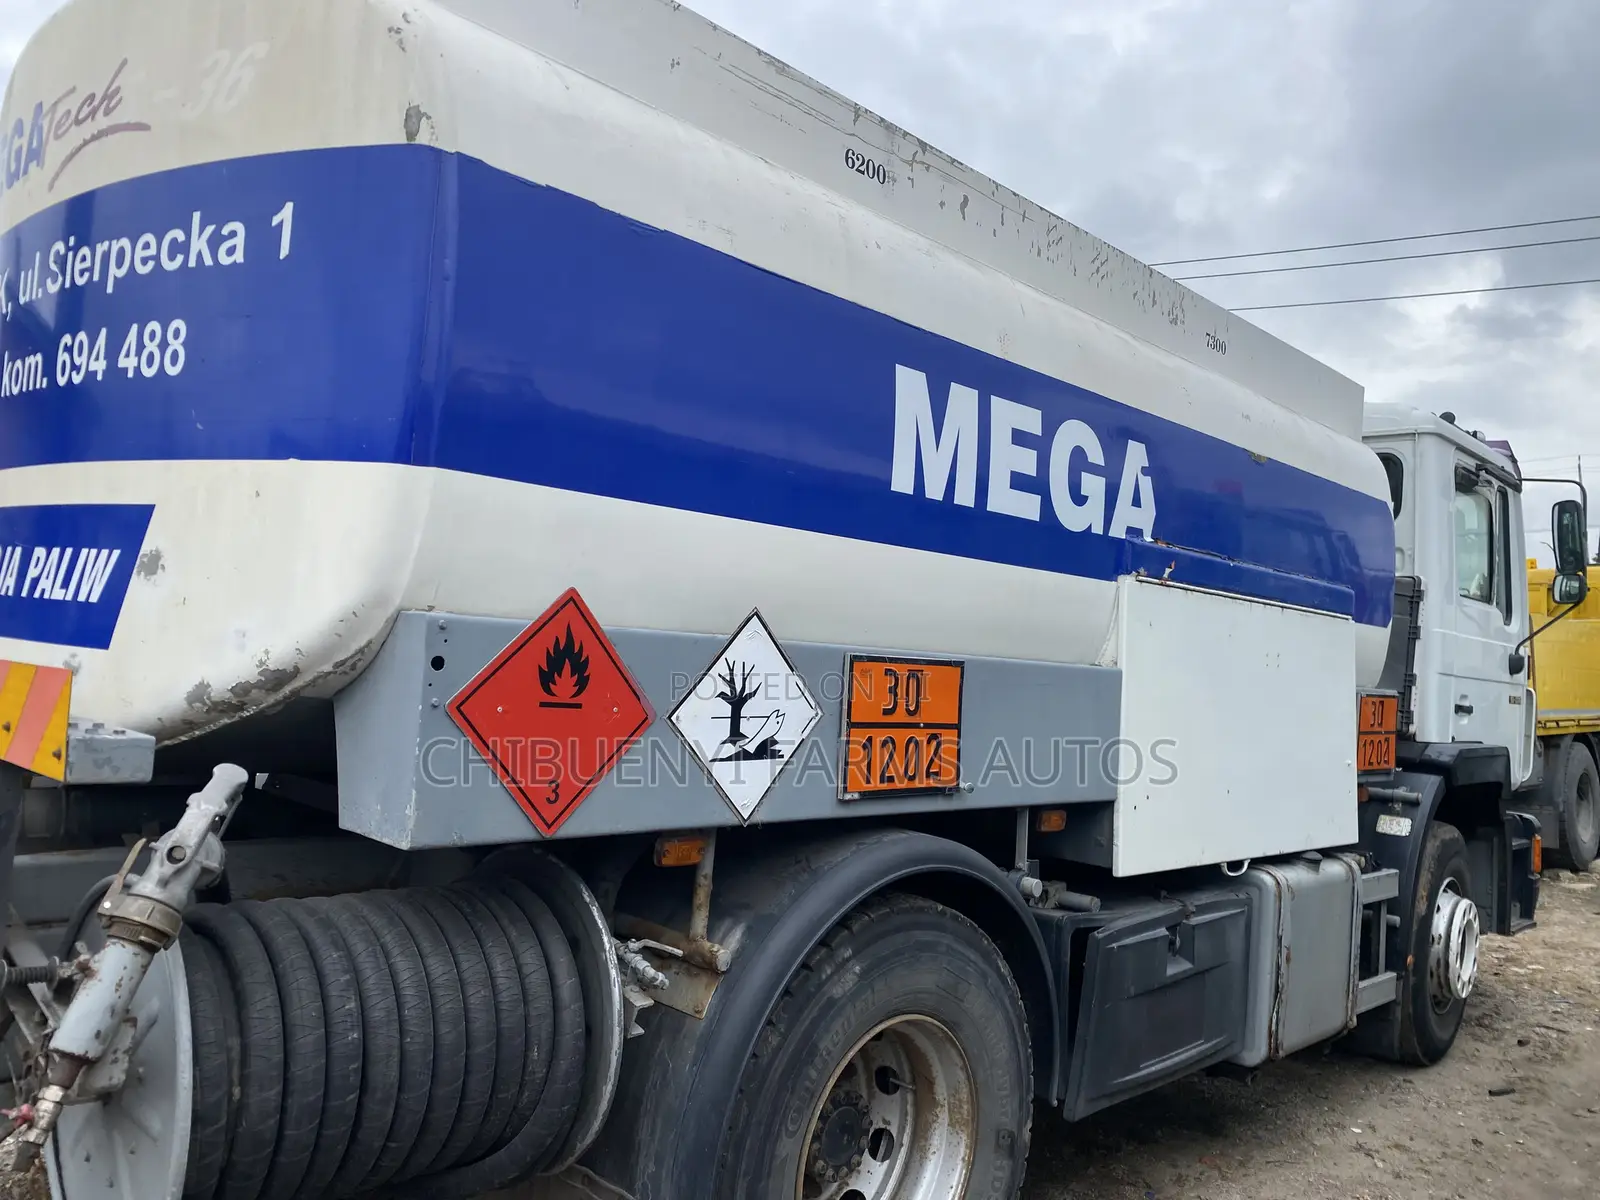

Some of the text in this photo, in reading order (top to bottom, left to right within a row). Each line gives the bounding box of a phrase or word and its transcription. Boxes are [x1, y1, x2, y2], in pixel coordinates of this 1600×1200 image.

[845, 148, 886, 185] 6200
[18, 251, 42, 305] ul.
[46, 211, 245, 294] Sierpecka
[271, 201, 295, 260] 1
[1, 319, 187, 398] kom. 694 488
[1205, 332, 1227, 356] 7300
[891, 363, 1157, 542] MEGA
[21, 546, 121, 603] PALIW
[882, 667, 924, 717] 30
[1370, 700, 1385, 728] 30
[861, 731, 943, 785] 1202
[545, 780, 561, 805] 3
